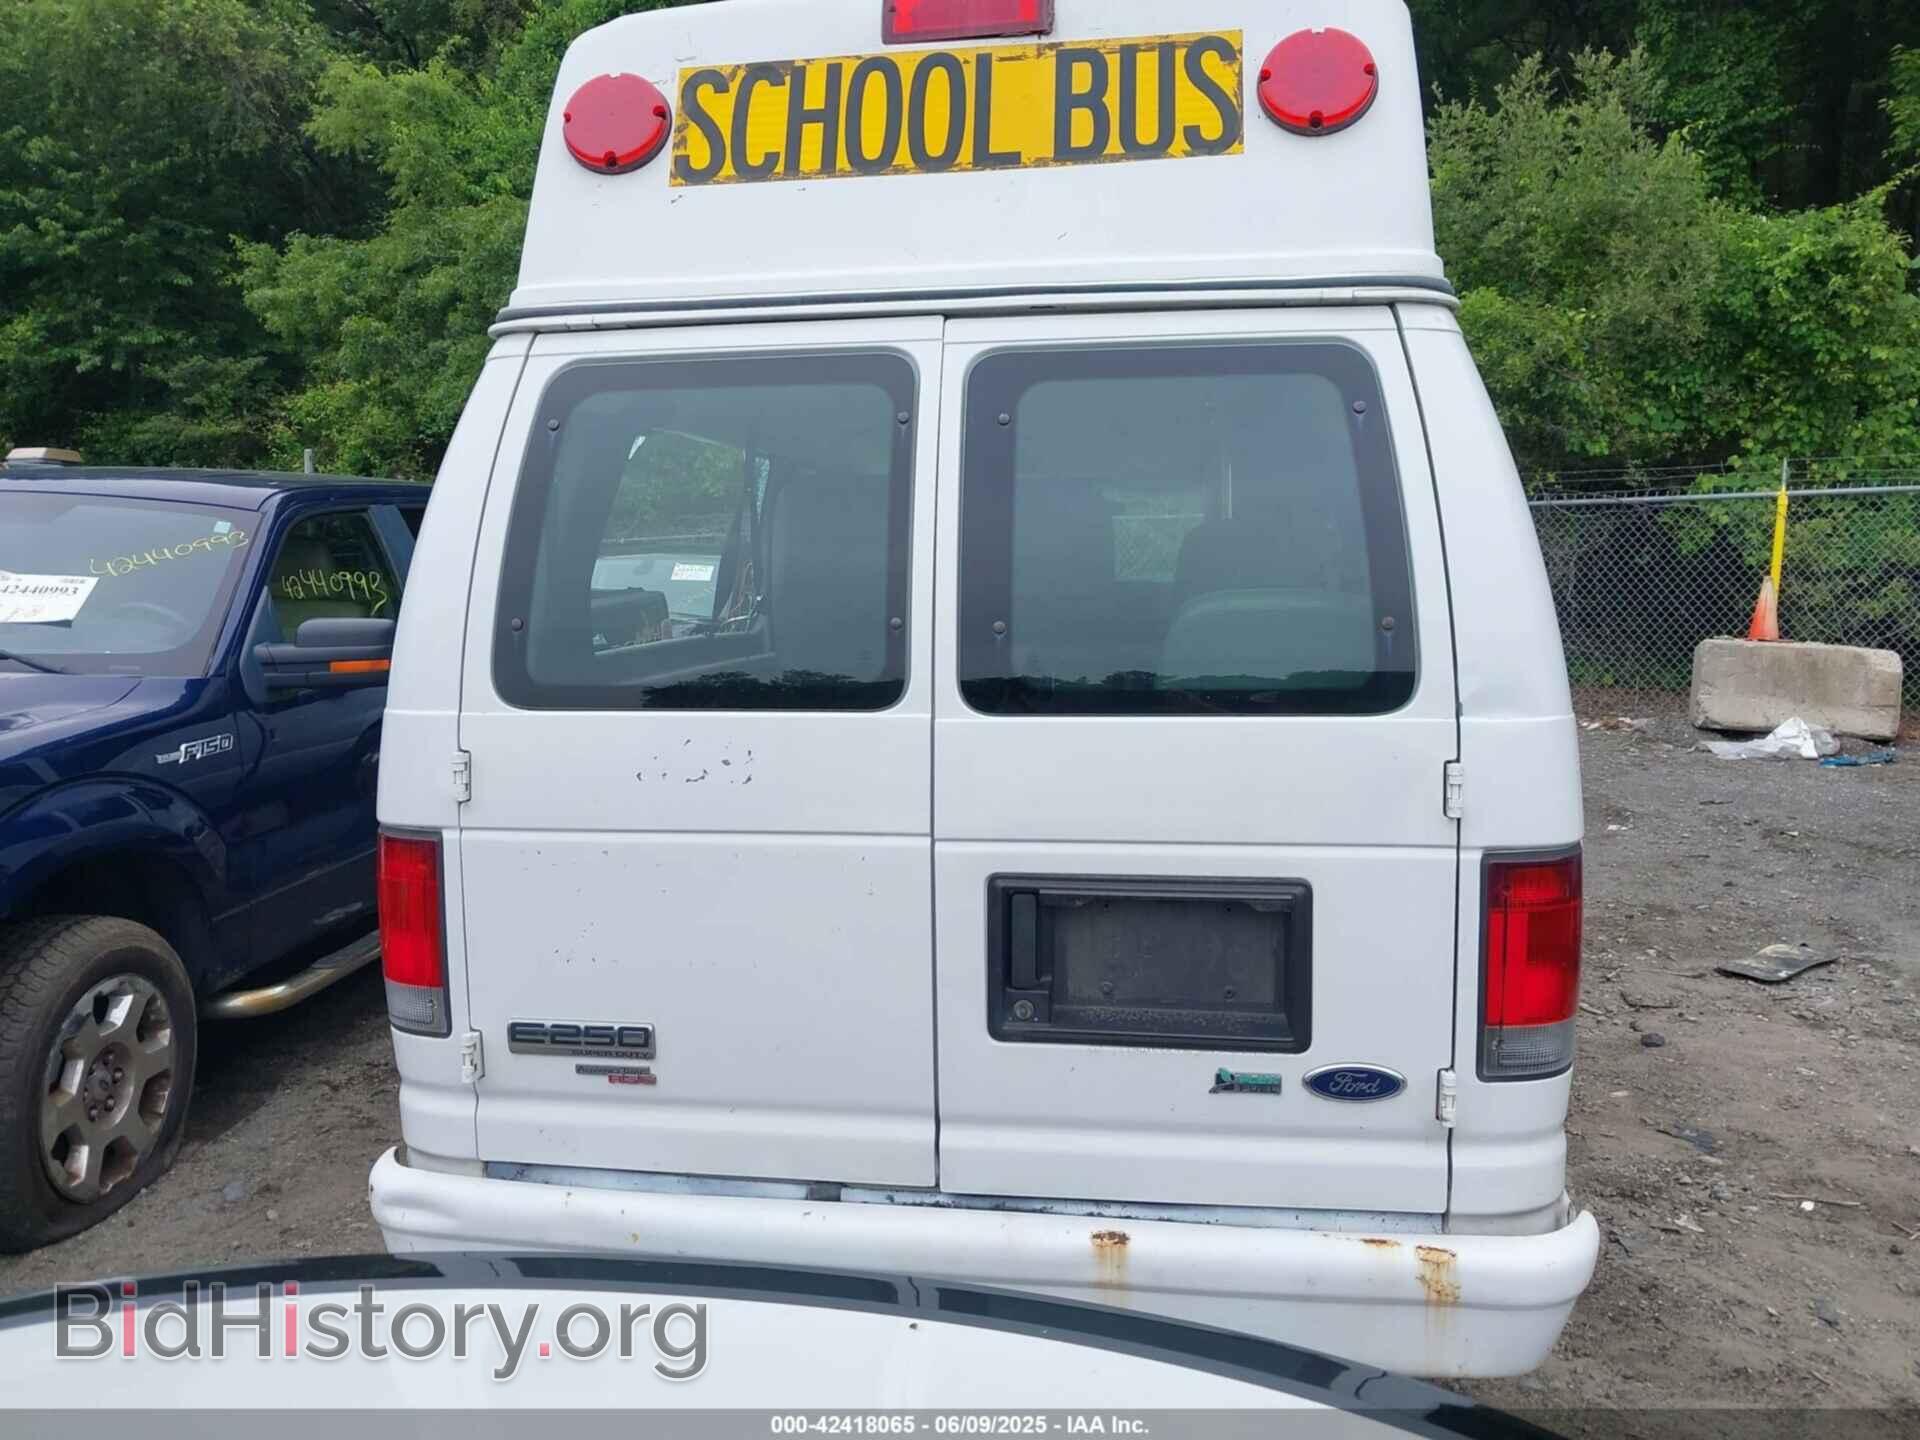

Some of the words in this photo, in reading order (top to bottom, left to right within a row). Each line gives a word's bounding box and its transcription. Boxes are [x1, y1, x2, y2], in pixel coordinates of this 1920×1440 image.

[673, 51, 1021, 186] SCHOOL
[1053, 35, 1242, 162] BUS
[89, 530, 249, 576] 42440993
[281, 568, 388, 617] 42440993
[510, 1021, 649, 1047] E250
[1329, 1071, 1379, 1093] Ford
